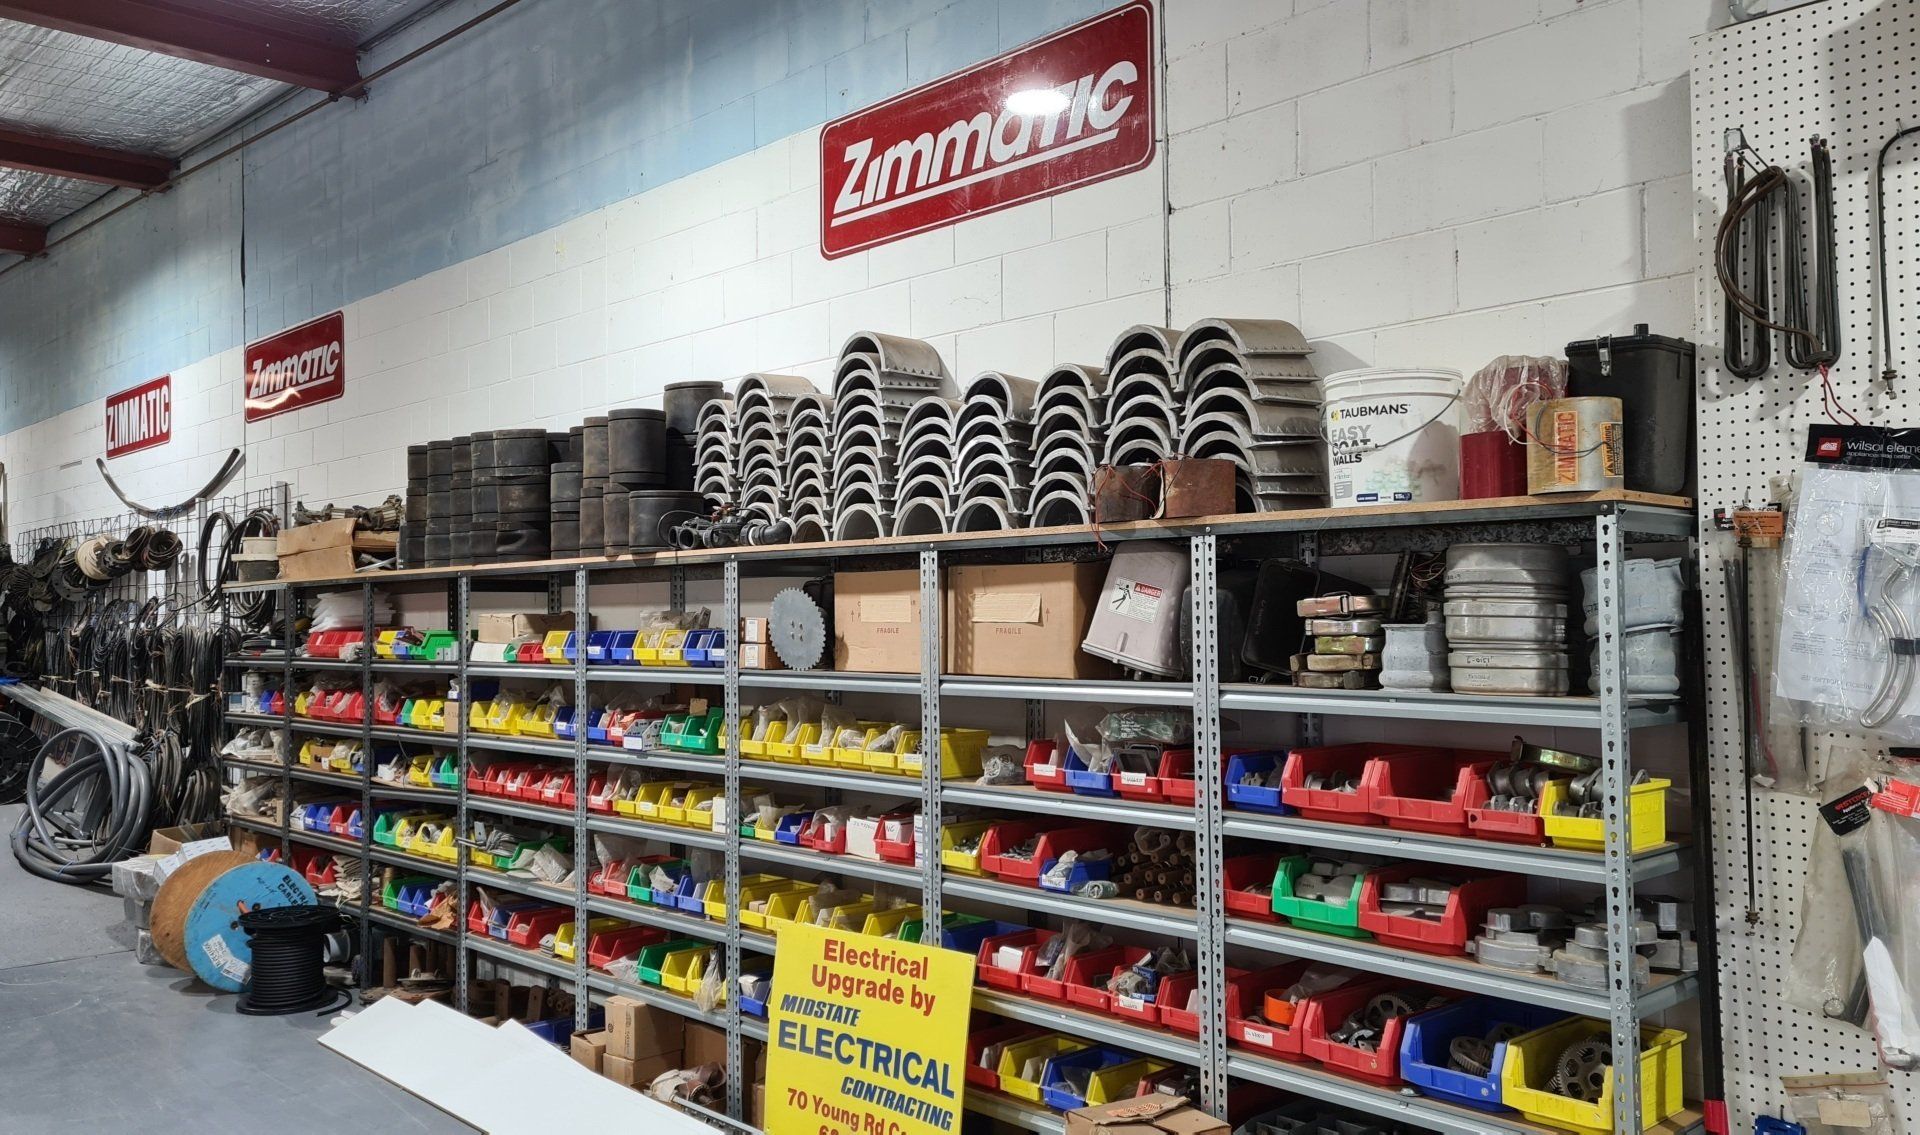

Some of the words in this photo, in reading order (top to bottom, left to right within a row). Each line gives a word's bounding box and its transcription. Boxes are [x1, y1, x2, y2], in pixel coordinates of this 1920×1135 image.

[107, 384, 169, 451] ZIMMATIC
[1339, 403, 1408, 419] TAUBMANS
[1331, 424, 1372, 443] EASY
[1557, 412, 1576, 482] ZIMMATIC
[1332, 453, 1363, 467] WALLS
[1140, 585, 1161, 597] DANGER
[995, 627, 1022, 635] FRAGILE
[823, 938, 929, 981] Electrical
[779, 994, 862, 1027] MIDSTATE
[811, 964, 905, 1004] Upgrade
[910, 984, 936, 1016] by
[778, 1019, 955, 1099] ELECTRICAL
[787, 1087, 808, 1111] 70
[812, 1095, 860, 1132] Young
[863, 1112, 885, 1135] Rd
[889, 1121, 908, 1135] C
[840, 1076, 954, 1131] CONTRACTING
